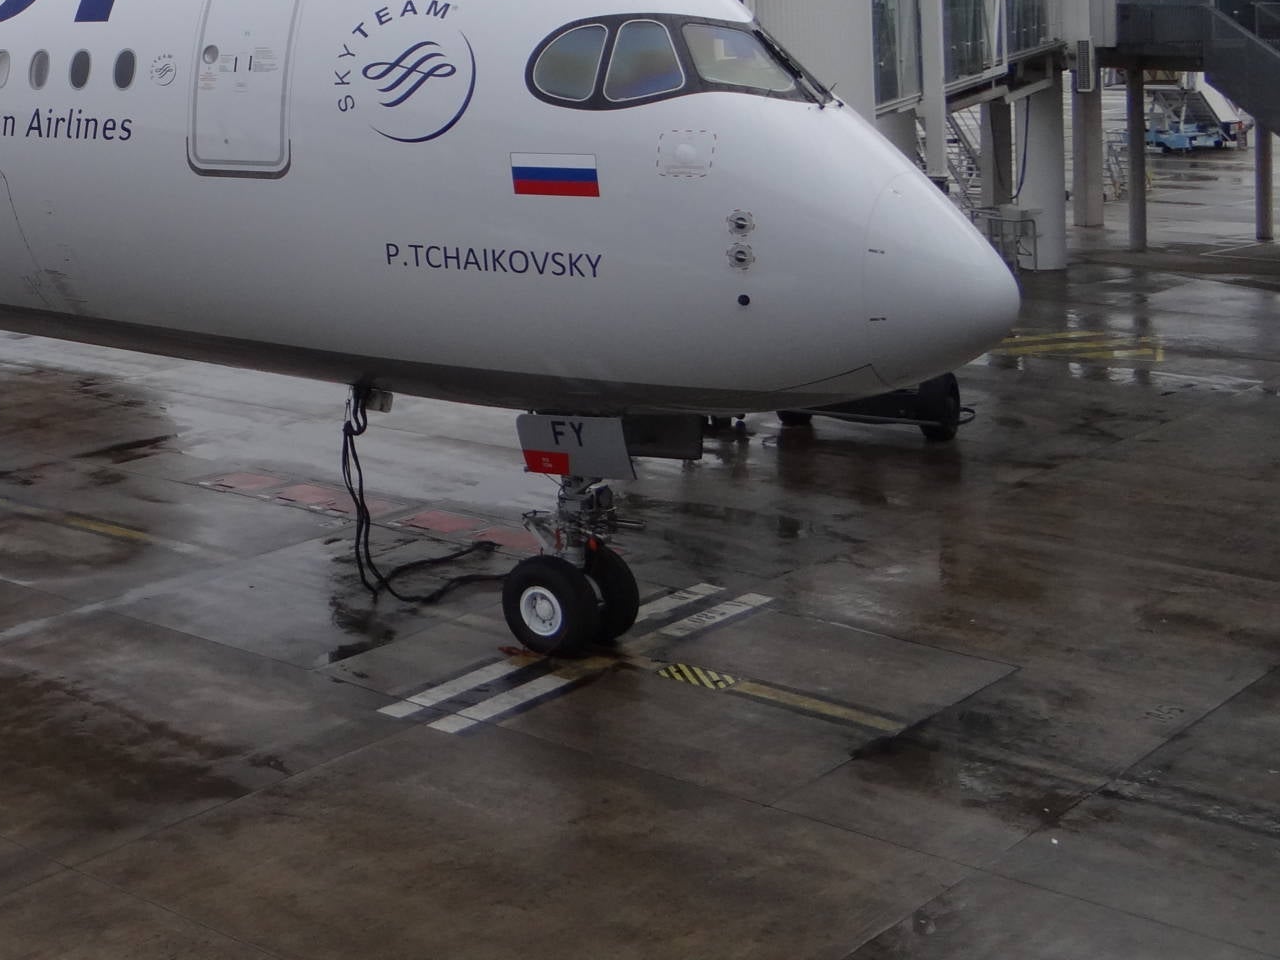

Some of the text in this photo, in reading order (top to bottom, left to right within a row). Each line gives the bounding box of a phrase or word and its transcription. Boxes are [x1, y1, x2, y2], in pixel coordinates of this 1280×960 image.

[25, 107, 134, 141] Airlines
[385, 242, 603, 279] P.TCHAIKOVSKY
[550, 420, 584, 447] FY
